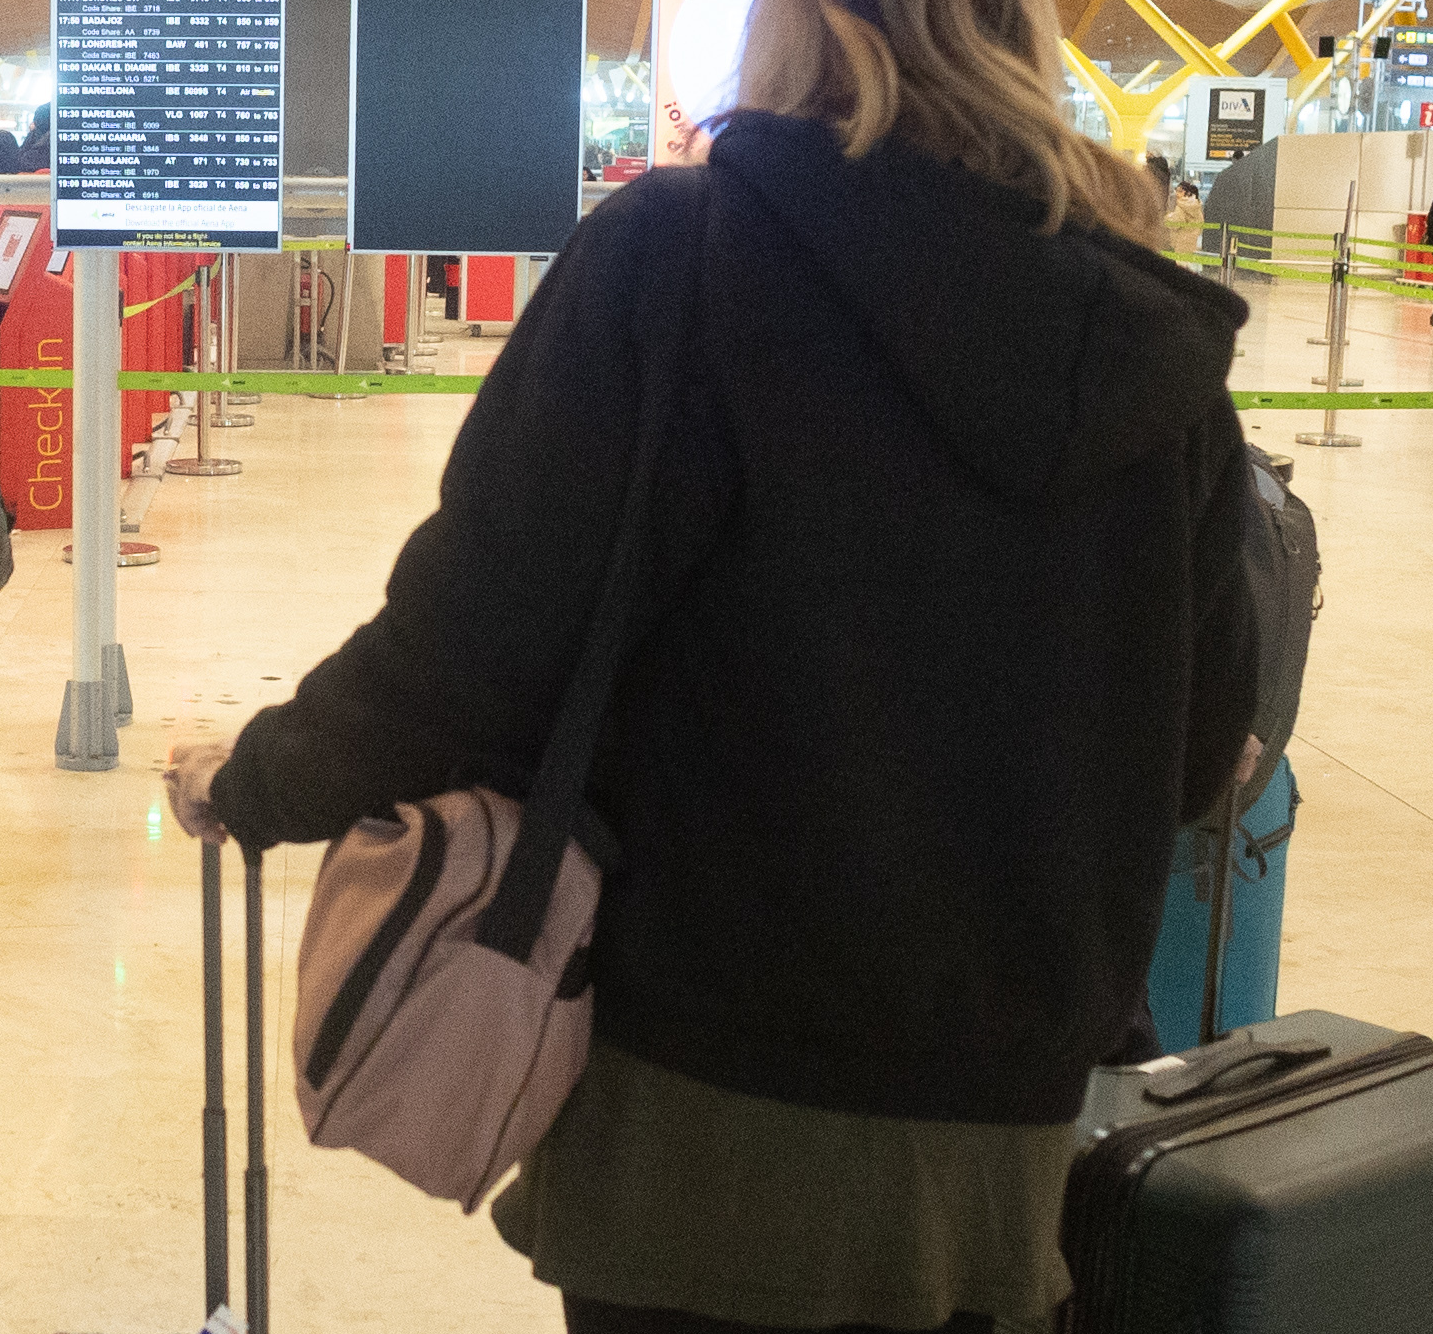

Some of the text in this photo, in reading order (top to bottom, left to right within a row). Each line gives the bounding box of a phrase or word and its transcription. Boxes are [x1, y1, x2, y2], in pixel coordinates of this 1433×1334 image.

[82, 134, 146, 142] GRAN CANARIA
[82, 180, 135, 188] BARCELONA
[125, 204, 167, 213] Descárgate
[177, 204, 191, 214] App
[218, 204, 226, 212] de
[229, 204, 247, 212] Aena
